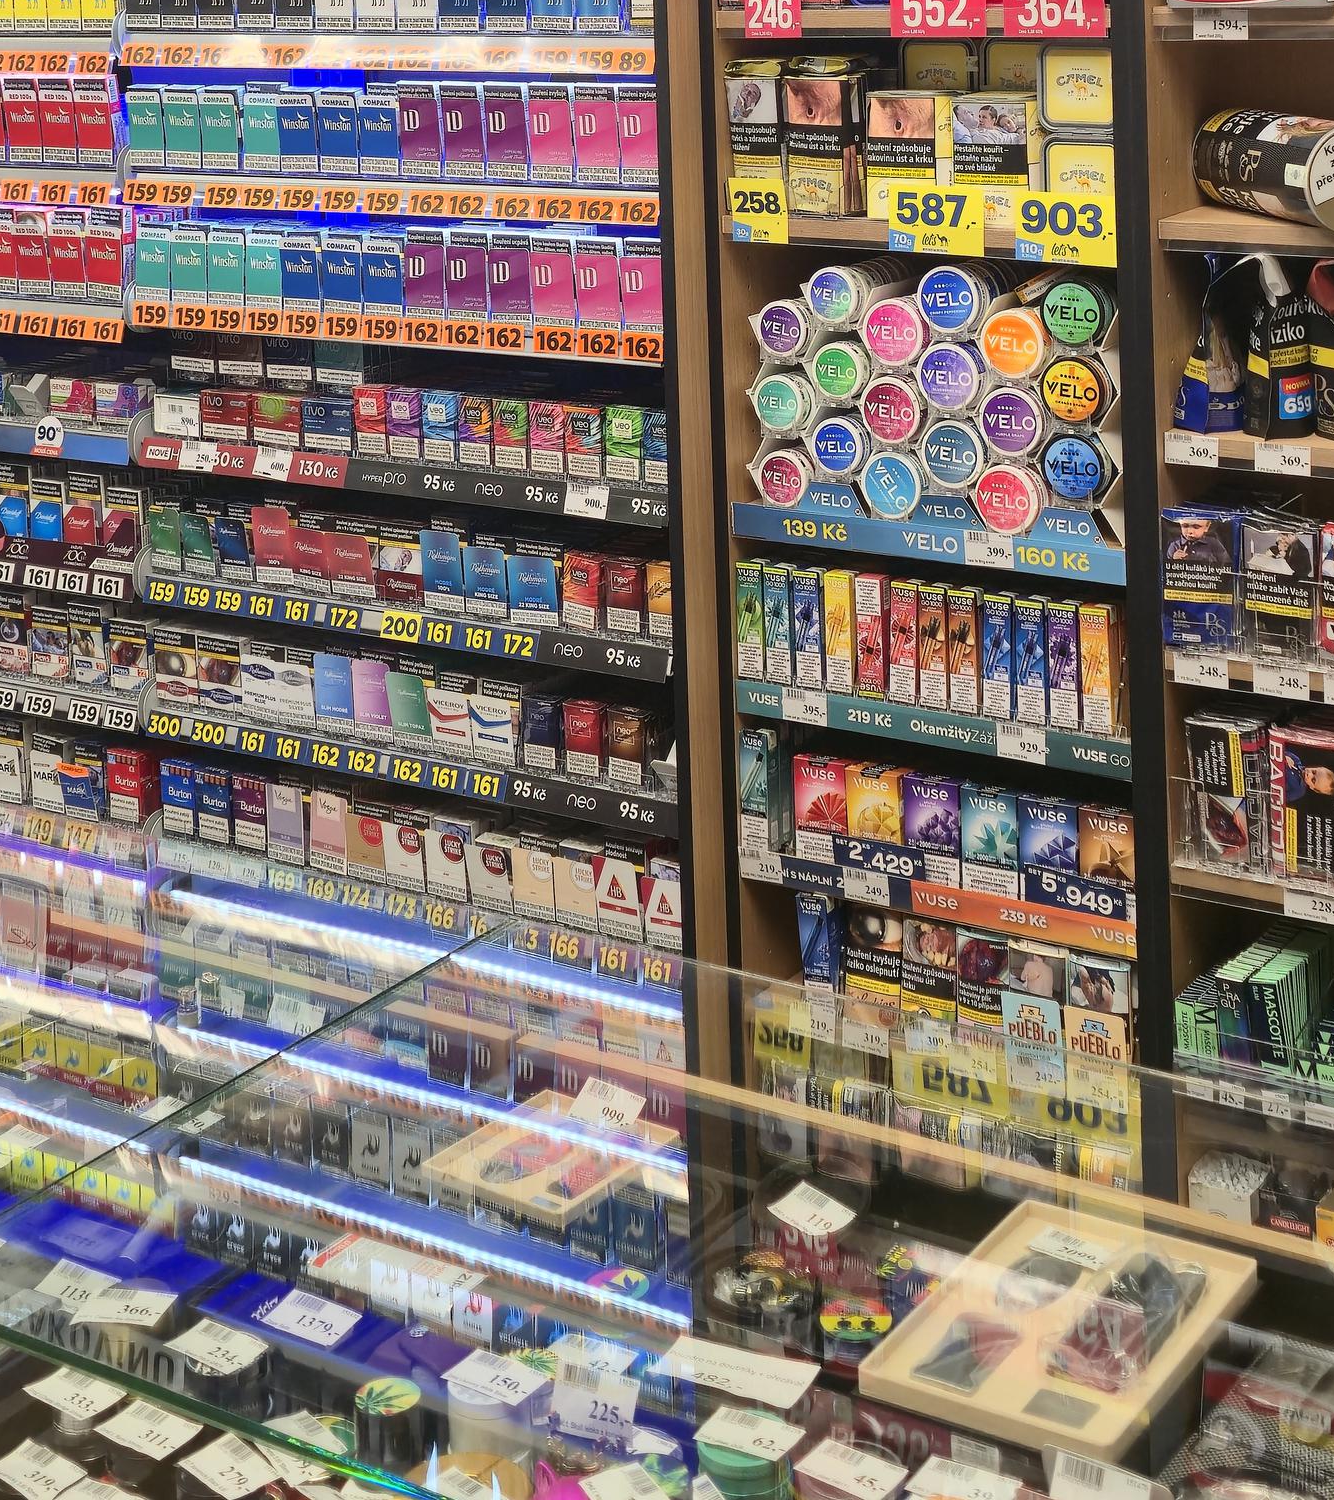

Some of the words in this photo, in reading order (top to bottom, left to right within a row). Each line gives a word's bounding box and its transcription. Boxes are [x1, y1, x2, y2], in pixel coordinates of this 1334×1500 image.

[1212, 19, 1248, 32] 1594,-
[1056, 72, 1103, 88] CAMEL
[733, 191, 786, 215] 258,-
[896, 193, 977, 229] 587,-
[1020, 204, 1114, 240] 903,-
[923, 291, 972, 308] VELO
[1045, 304, 1098, 323] VELO
[985, 414, 1035, 431] VELO
[37, 426, 56, 441] 90
[299, 459, 323, 478] 130
[325, 464, 338, 478] Kč
[1045, 459, 1099, 478] VELO
[423, 475, 440, 490] 95
[442, 478, 455, 492] Kč
[474, 482, 503, 497] neo
[810, 491, 851, 509] VELO
[782, 519, 816, 536] 139
[821, 522, 848, 542] Kč
[902, 531, 958, 554] VELO
[987, 547, 1012, 559] 399,-
[1017, 547, 1056, 566] 160
[1061, 550, 1090, 572] Kč
[383, 617, 418, 638] 200
[748, 692, 779, 707] VUSE
[803, 703, 826, 718] 395,-
[848, 710, 870, 725] 219
[874, 711, 892, 728] Kč
[148, 715, 180, 737] 300
[910, 719, 972, 743] Okamžitý
[1019, 740, 1046, 755] 929,-
[1072, 747, 1107, 764] VUSE
[1110, 752, 1130, 767] GO
[871, 852, 914, 876] 429
[1066, 887, 1113, 915] 949
[999, 908, 1024, 926] 239
[1024, 912, 1048, 929] Kč
